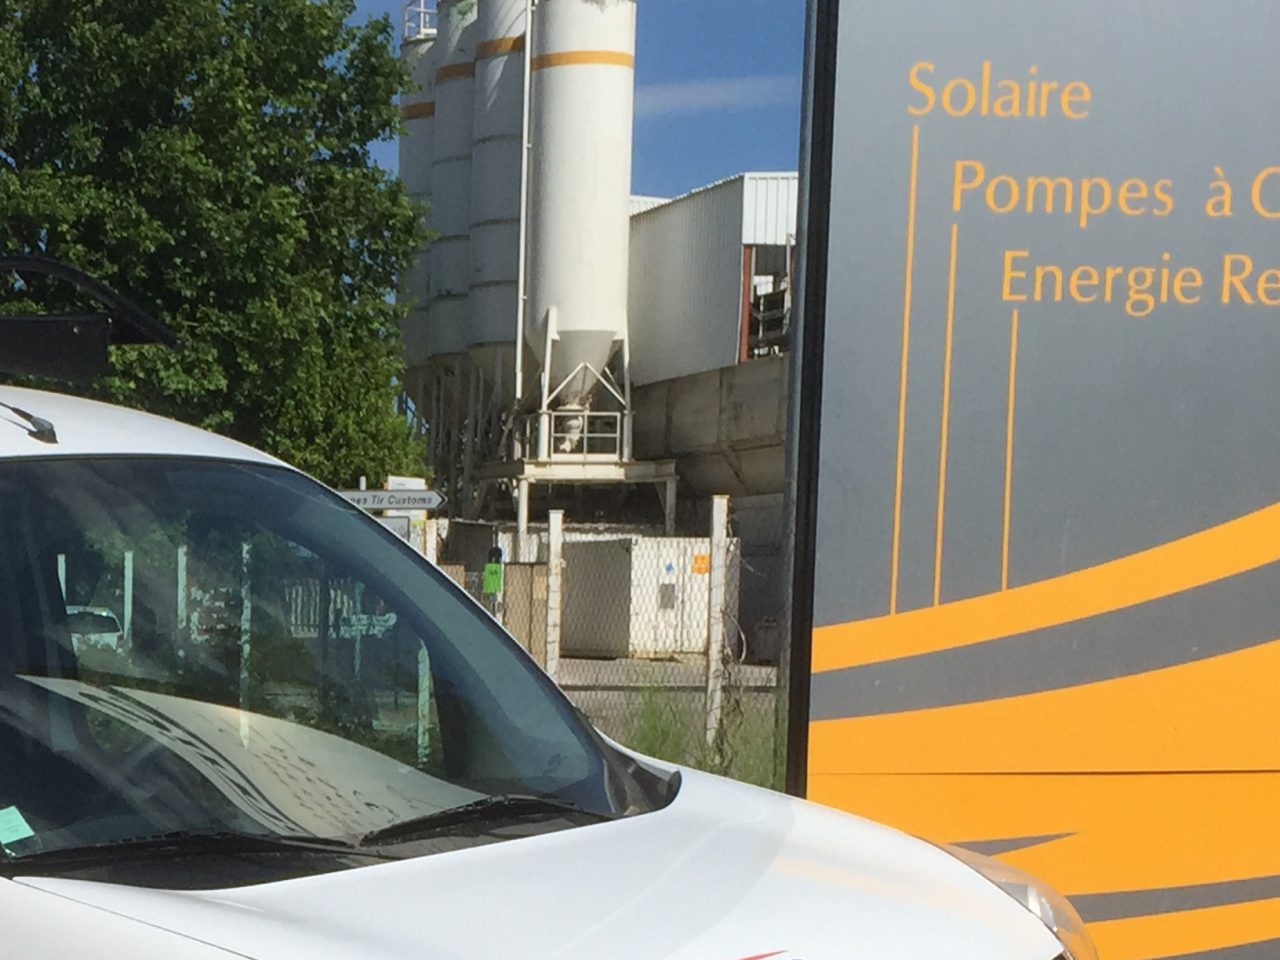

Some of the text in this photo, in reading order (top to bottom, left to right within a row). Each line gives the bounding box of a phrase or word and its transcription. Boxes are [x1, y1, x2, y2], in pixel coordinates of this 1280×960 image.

[907, 60, 1092, 119] Solaire
[952, 160, 1174, 228] Pompes
[1205, 166, 1233, 218] à
[1001, 249, 1203, 317] Energie
[387, 494, 433, 505] Customs
